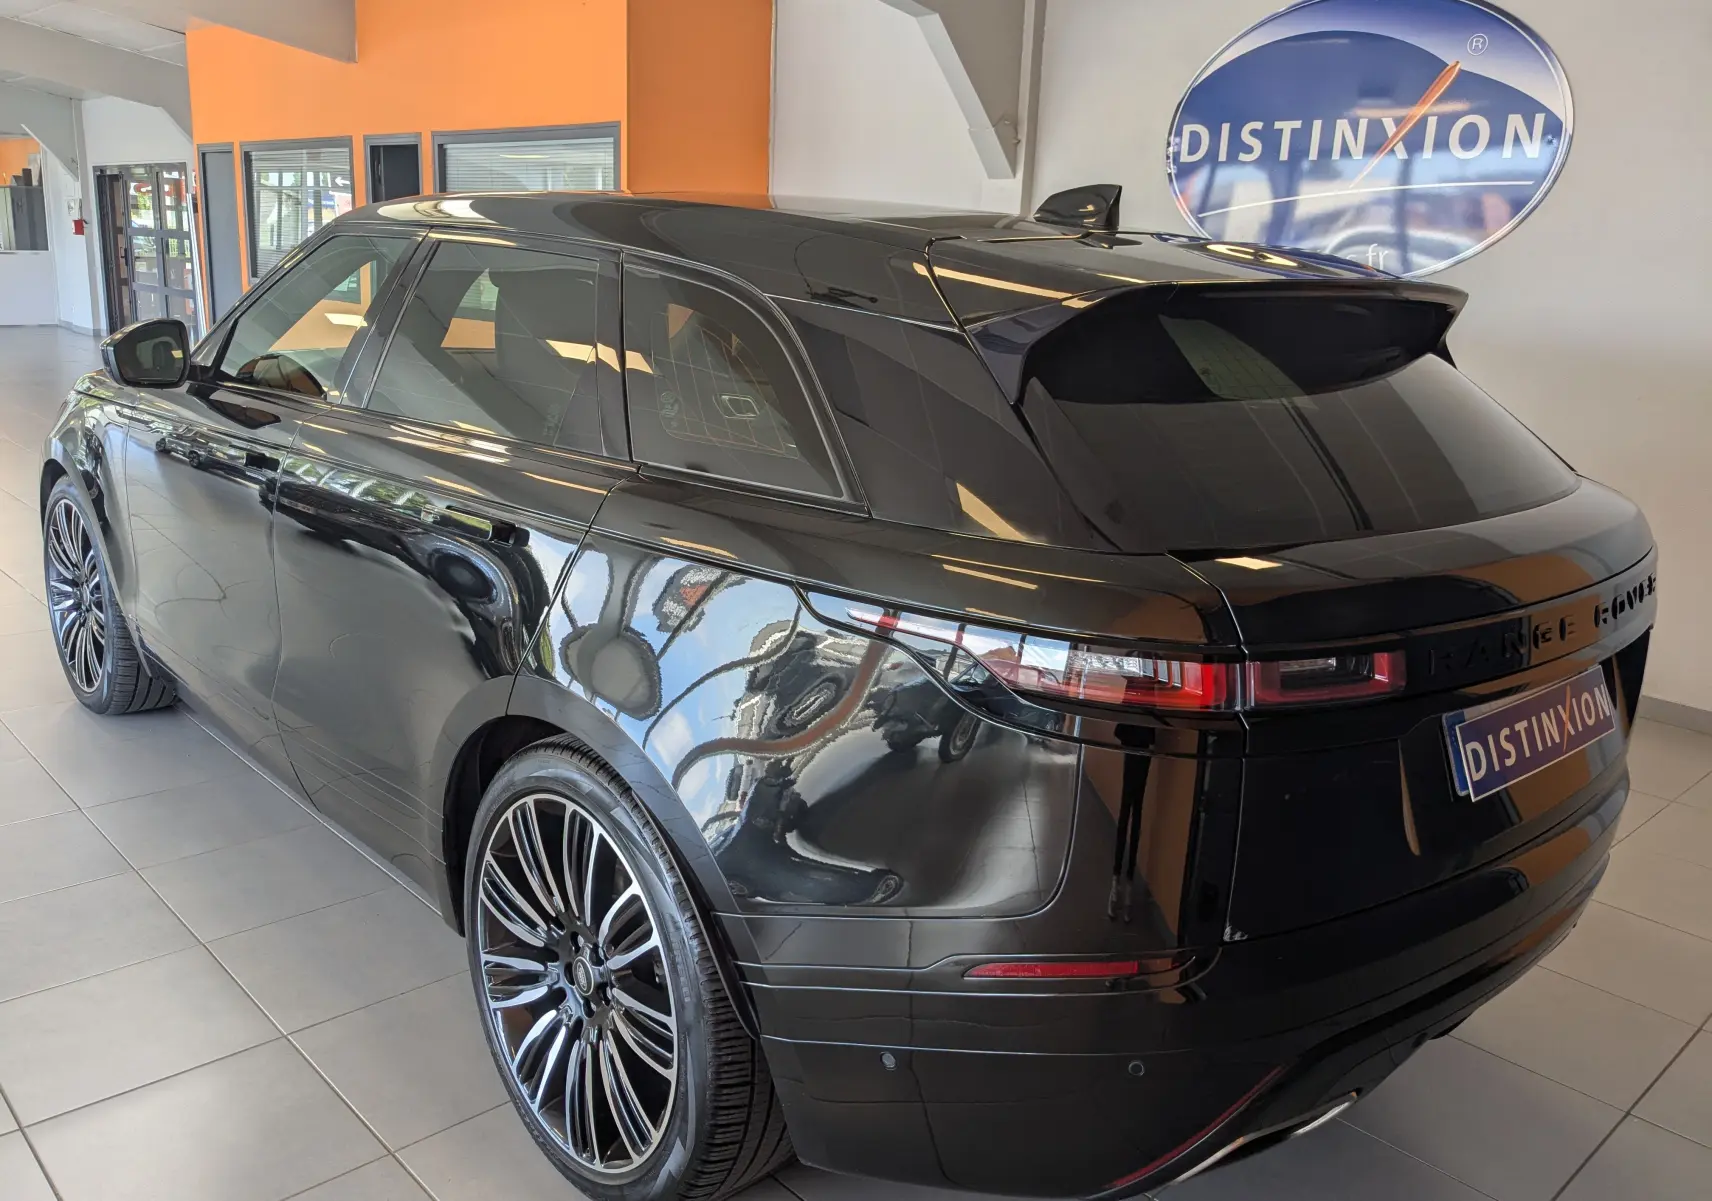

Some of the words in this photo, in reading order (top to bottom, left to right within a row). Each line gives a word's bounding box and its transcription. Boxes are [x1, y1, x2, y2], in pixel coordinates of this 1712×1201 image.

[1179, 113, 1546, 163] DISTINXION
[1428, 614, 1577, 676] RANGE
[1464, 683, 1611, 783] DISTINXION
